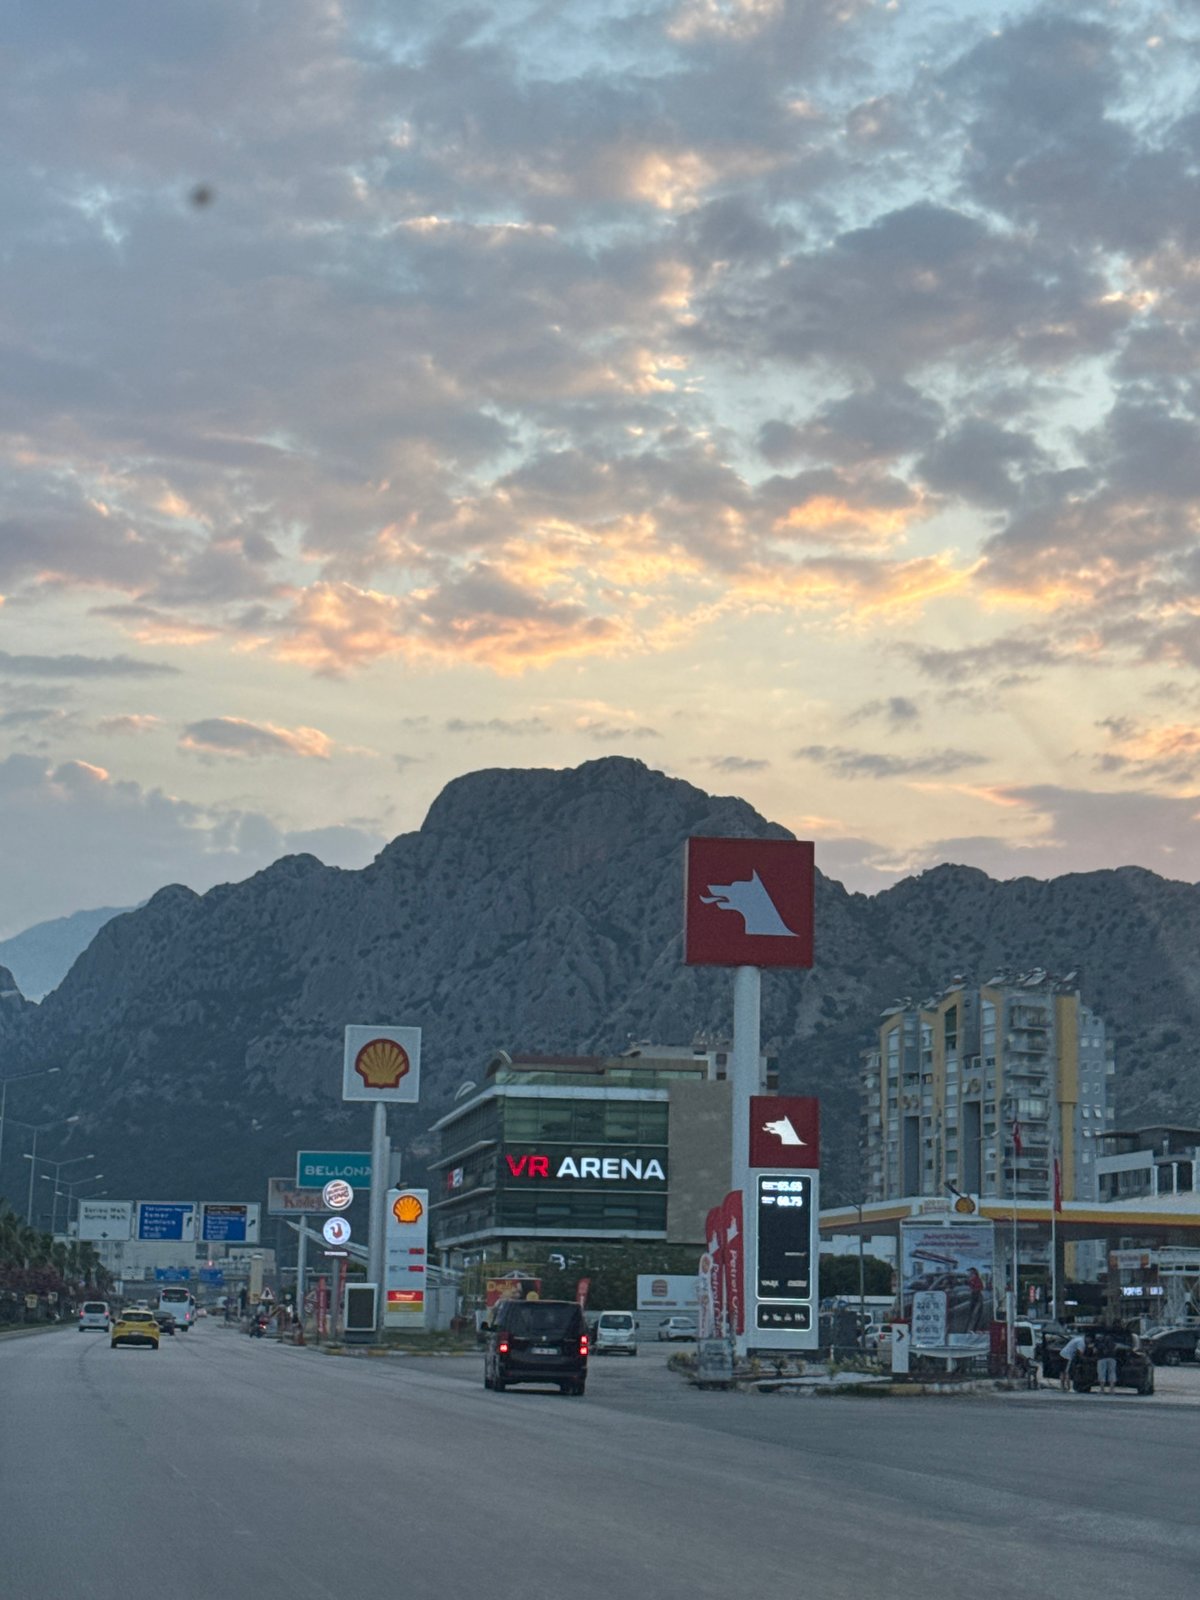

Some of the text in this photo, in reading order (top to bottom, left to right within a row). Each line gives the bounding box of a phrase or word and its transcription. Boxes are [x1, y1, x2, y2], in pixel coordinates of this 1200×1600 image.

[304, 1165, 373, 1176] BELLONA
[505, 1154, 666, 1180] VR ARENA
[711, 1263, 720, 1304] Petrol
[729, 1249, 738, 1293] Petrol
